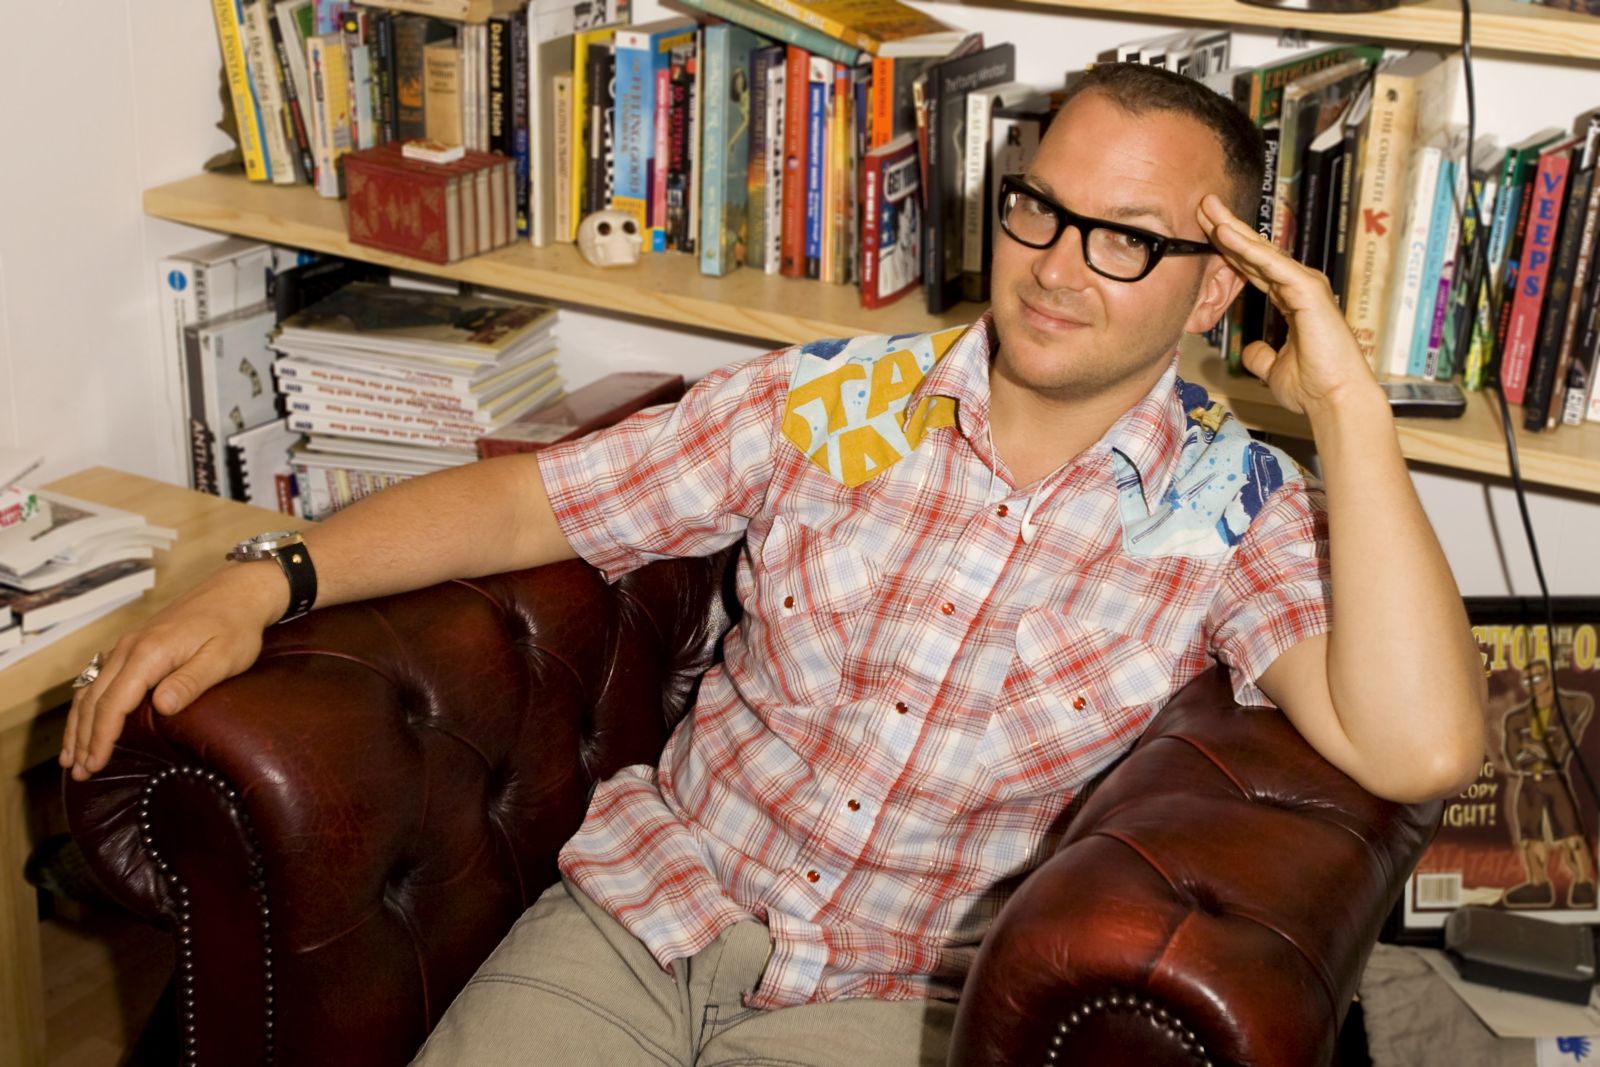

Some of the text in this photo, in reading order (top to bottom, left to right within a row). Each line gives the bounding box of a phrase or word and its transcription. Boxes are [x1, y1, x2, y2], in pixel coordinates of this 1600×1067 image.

[221, 33, 243, 85] POSTAL
[249, 35, 263, 57] the
[254, 60, 272, 103] media
[489, 22, 504, 136] Database Nation
[629, 76, 642, 141] FEELING
[1381, 110, 1393, 133] THE
[673, 108, 684, 170] YESTERDAY
[628, 146, 640, 192] GOOD
[1261, 140, 1278, 192] Playing
[1371, 138, 1389, 202] COMPLETE
[1260, 195, 1276, 221] For
[1578, 209, 1598, 256] WALKING
[1524, 173, 1563, 298] VEEPS
[1357, 240, 1377, 321] CHRONICLES
[1572, 257, 1587, 288] DEAD
